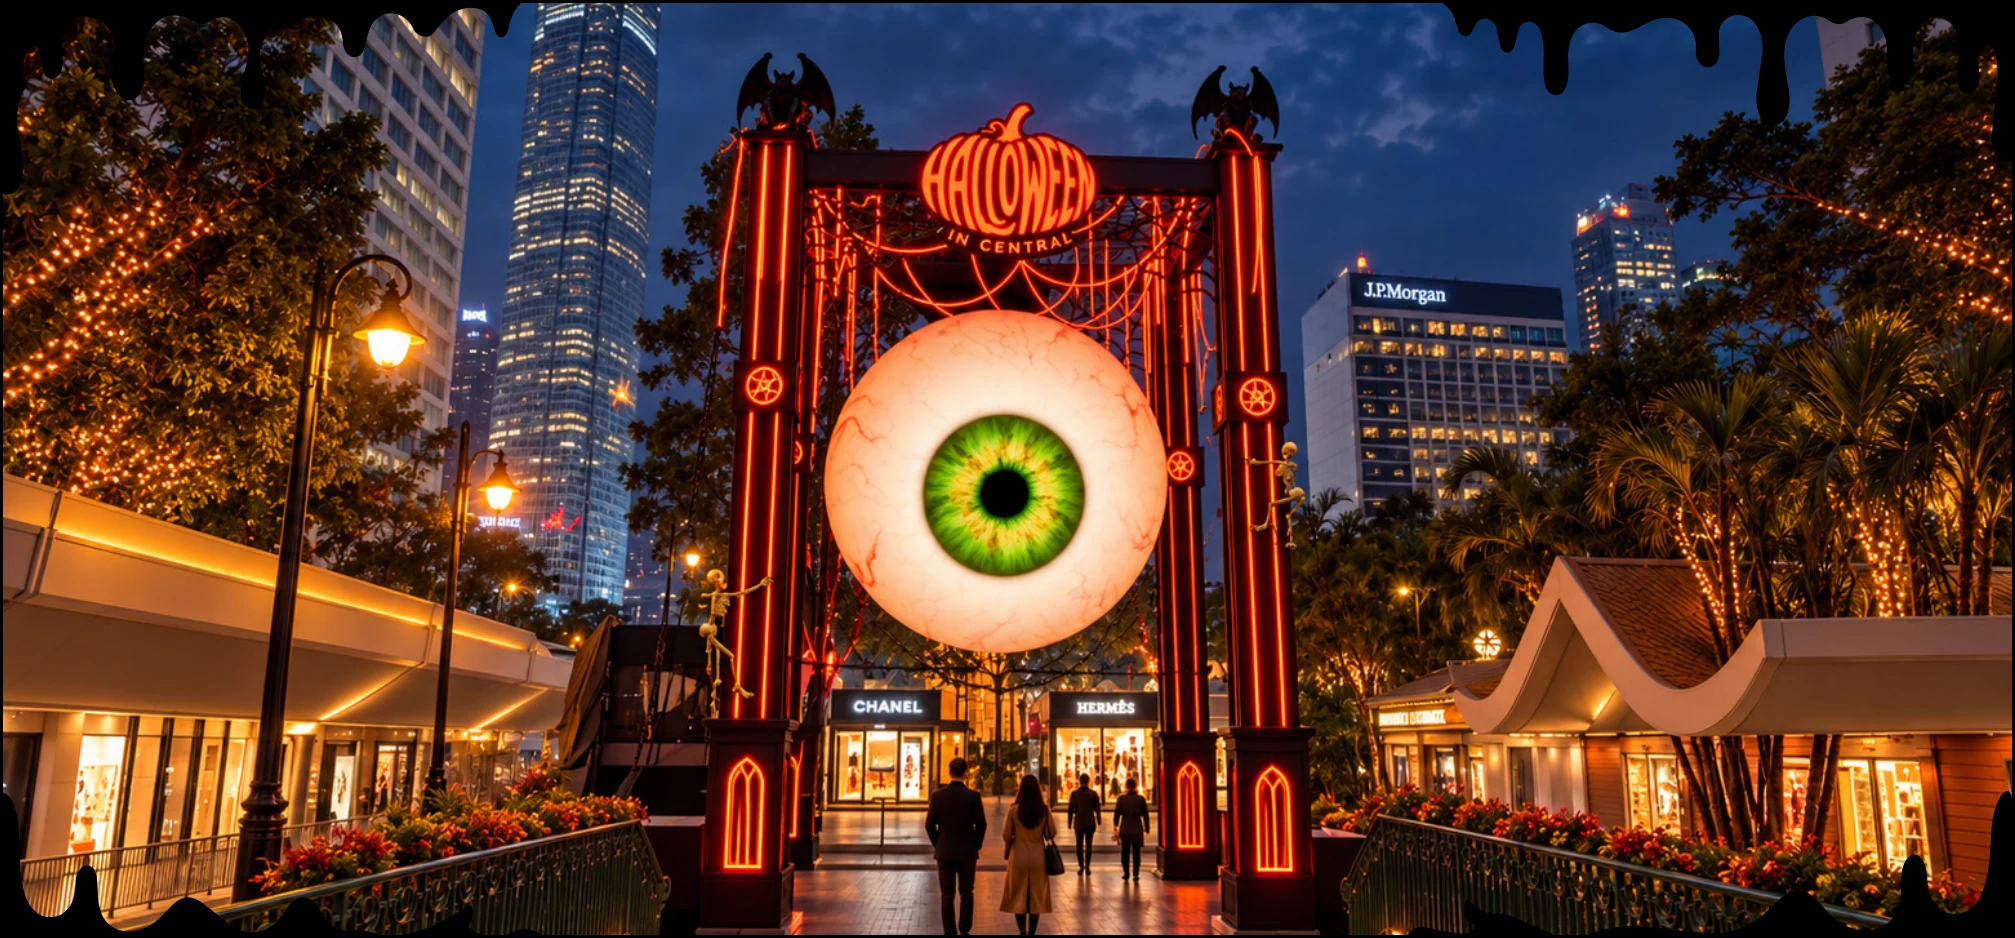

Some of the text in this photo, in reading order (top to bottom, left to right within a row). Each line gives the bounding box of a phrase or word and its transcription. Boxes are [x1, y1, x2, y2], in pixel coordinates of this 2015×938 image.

[922, 134, 1095, 236] HALLOWEEN
[948, 229, 1073, 254] IN CENTRAL
[1364, 282, 1446, 305] J.P.Morgan
[853, 700, 923, 713] CHANEL
